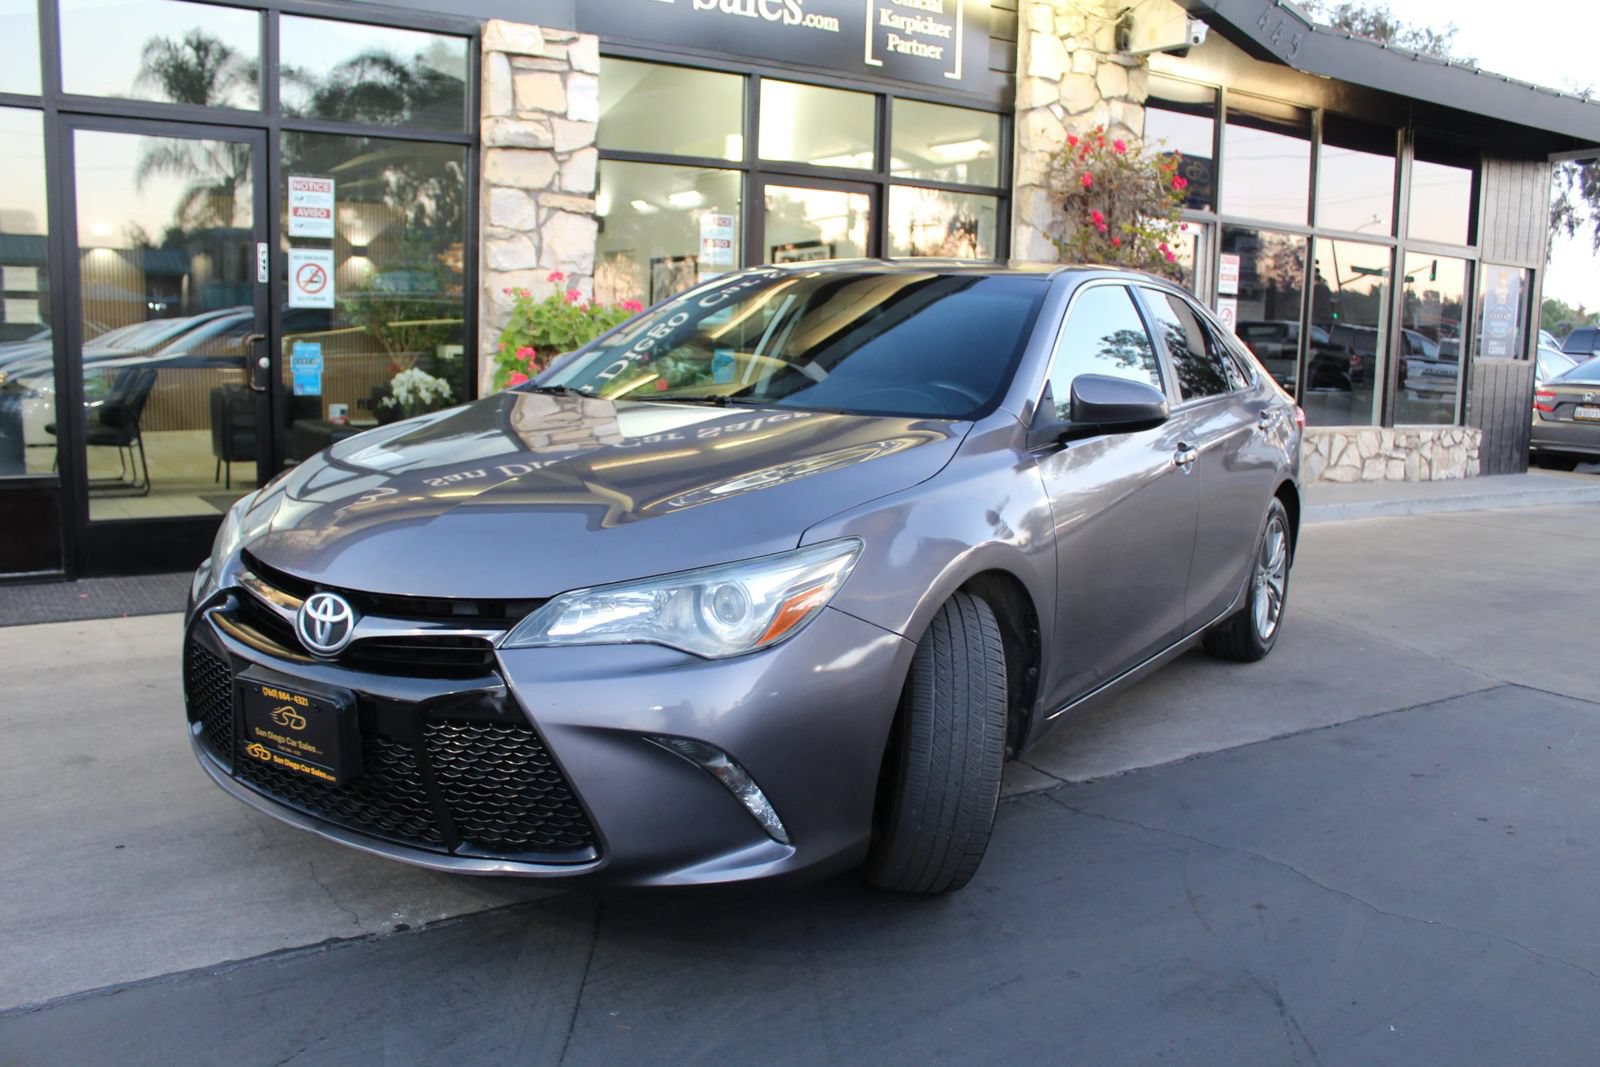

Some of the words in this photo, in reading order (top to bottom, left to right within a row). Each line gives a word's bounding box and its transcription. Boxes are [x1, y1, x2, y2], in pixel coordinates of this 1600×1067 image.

[693, 0, 840, 32] es.com
[889, 0, 944, 14] cial
[879, 8, 952, 38] Karpicker
[886, 33, 944, 60] Partner
[294, 181, 329, 192] NOTICE
[297, 208, 327, 218] AVISO
